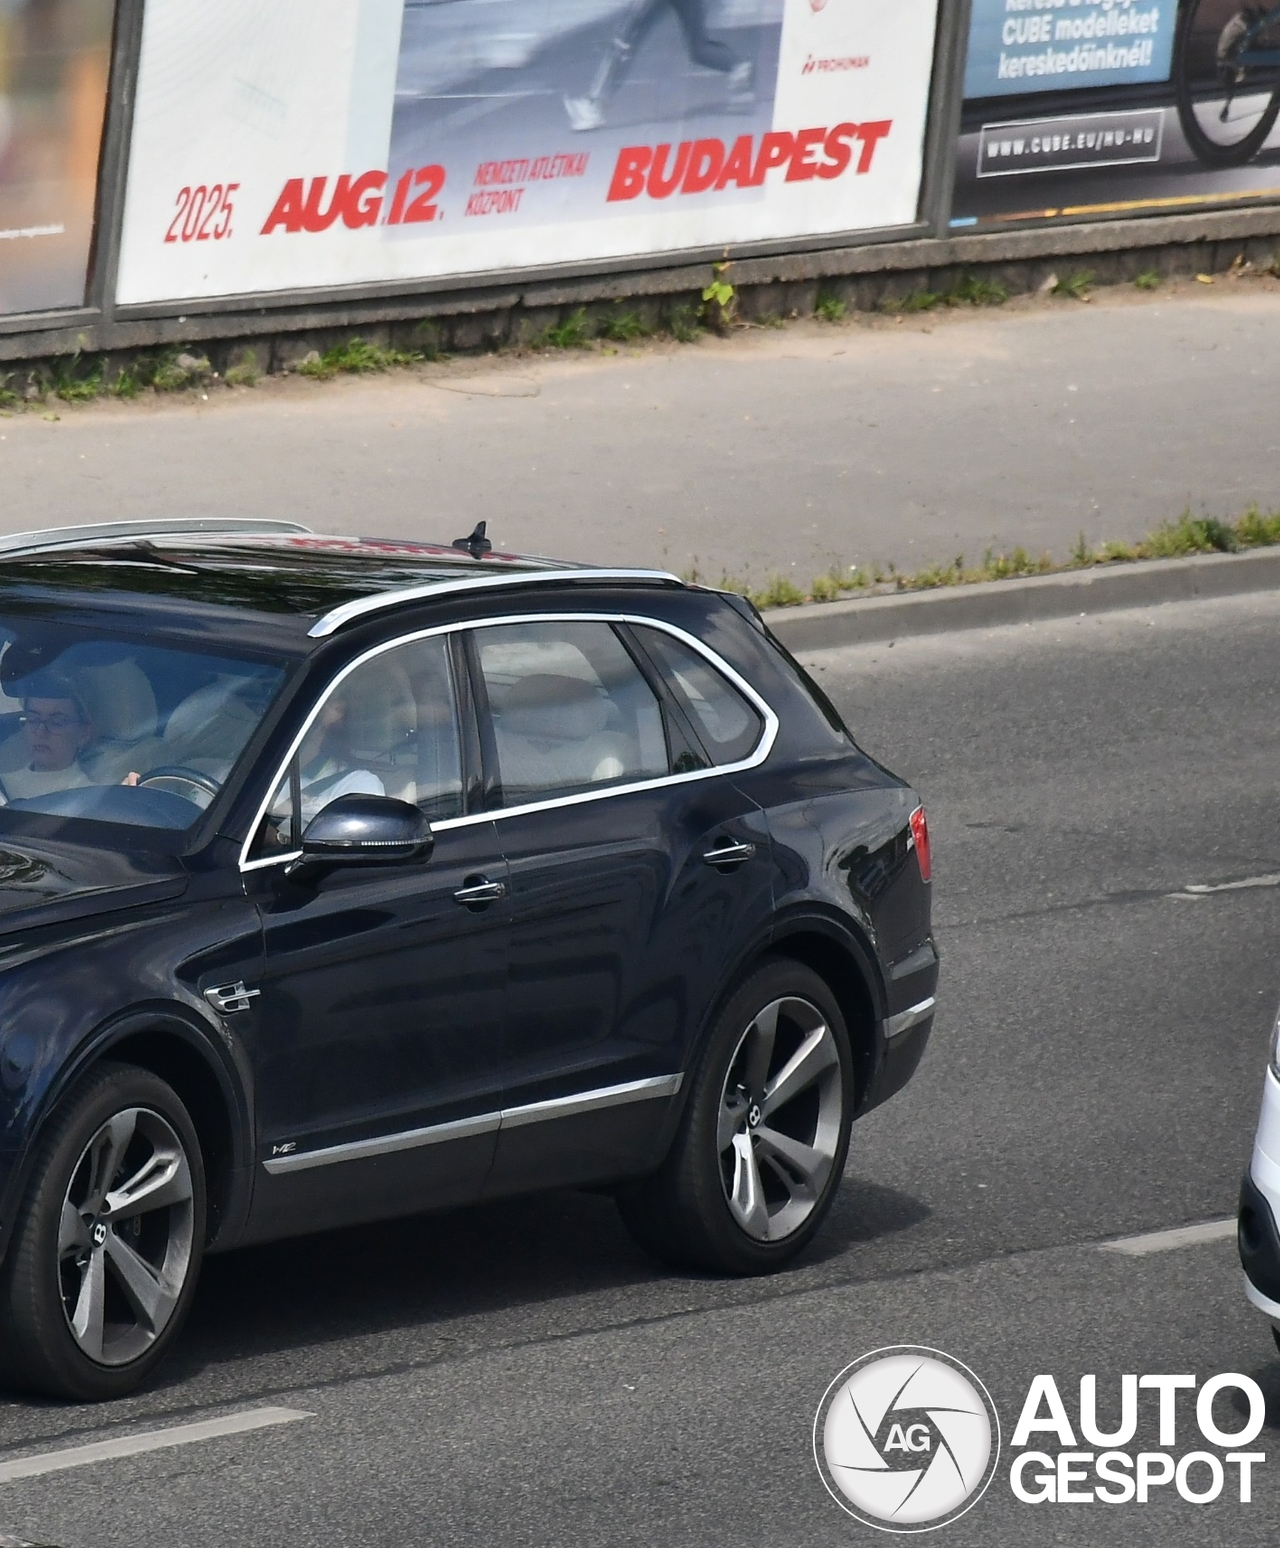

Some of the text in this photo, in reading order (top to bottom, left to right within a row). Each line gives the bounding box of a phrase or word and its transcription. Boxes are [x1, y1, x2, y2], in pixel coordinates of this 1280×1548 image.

[1002, 7, 1159, 46] CUBE modelleket
[987, 128, 1154, 158] WWW.CUBE.EU/HU-HU
[474, 158, 529, 186] NEMZETI
[606, 119, 893, 202] BUDAPEST
[163, 183, 240, 243] 2025.
[465, 188, 525, 217] KÖZPONT
